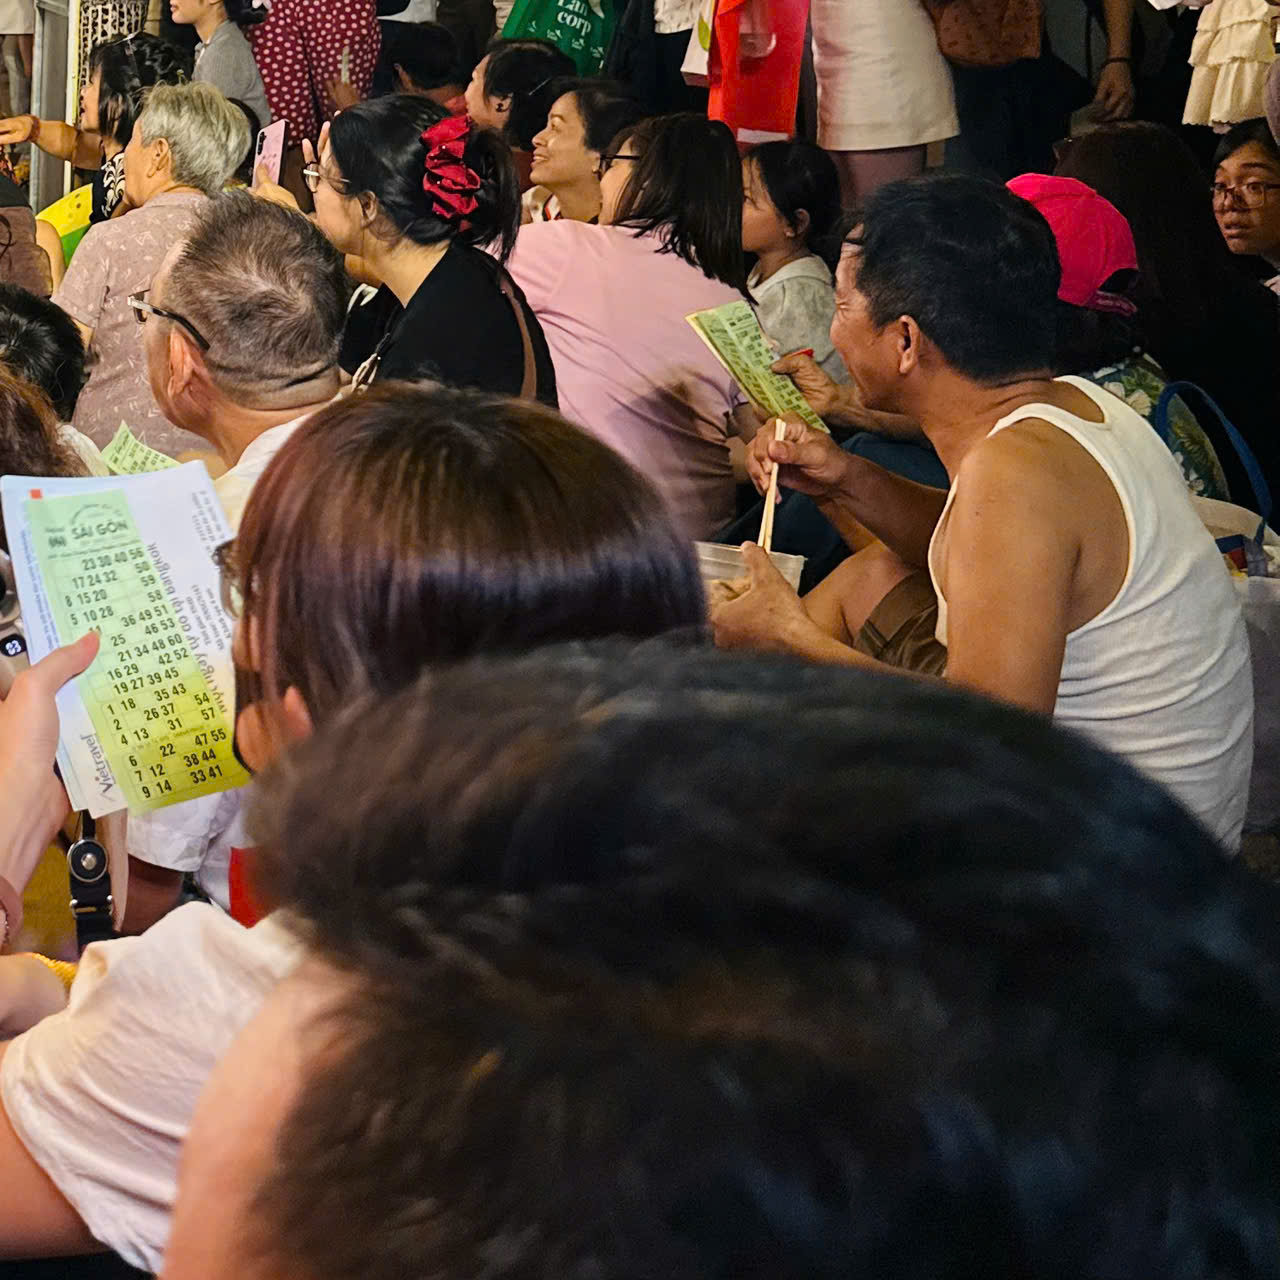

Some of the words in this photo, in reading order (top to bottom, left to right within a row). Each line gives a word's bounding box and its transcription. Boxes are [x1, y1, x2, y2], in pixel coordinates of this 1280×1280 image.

[557, 11, 592, 36] corp
[72, 576, 84, 589] 17
[87, 574, 102, 586] 24
[103, 570, 117, 582] 32
[82, 558, 96, 570] 23
[77, 592, 91, 604] 15
[93, 589, 107, 601] 20
[141, 575, 155, 586] 59
[70, 614, 78, 625] 5
[83, 610, 97, 622] 10
[99, 606, 114, 618] 28
[147, 589, 162, 602] 58
[121, 615, 136, 627] 36
[139, 609, 152, 621] 49
[154, 604, 168, 617] 51
[111, 634, 126, 646] 25
[145, 623, 158, 635] 46
[160, 618, 175, 630] 53
[118, 650, 132, 661] 21
[134, 644, 149, 656] 34
[152, 639, 165, 651] 48
[167, 634, 182, 646] 60
[108, 668, 122, 680] 16
[124, 664, 139, 676] 29
[159, 653, 173, 665] 42
[173, 648, 189, 660] 52
[114, 682, 128, 694] 19
[130, 677, 144, 690] 27
[147, 673, 162, 685] 39
[165, 667, 178, 679] 45
[107, 704, 114, 715] 1
[121, 698, 136, 711] 18
[154, 689, 169, 701] 35
[172, 683, 186, 695] 43
[114, 719, 121, 730] 2
[144, 708, 159, 720] 26
[161, 703, 174, 716] 37
[195, 693, 210, 705] 54
[121, 734, 128, 745] 4
[134, 728, 149, 741] 13
[168, 718, 182, 730] 31
[201, 707, 215, 720] 57
[80, 733, 113, 793] Vietravel
[129, 755, 137, 767] 6
[160, 744, 176, 757] 22
[195, 733, 208, 746] 47
[211, 728, 226, 741] 55
[135, 771, 142, 781] 7
[150, 764, 165, 777] 12
[184, 754, 199, 767] 38
[202, 748, 216, 761] 44
[142, 786, 150, 798] 9
[156, 780, 172, 793] 14
[190, 770, 206, 784] 33
[209, 765, 222, 778] 41
